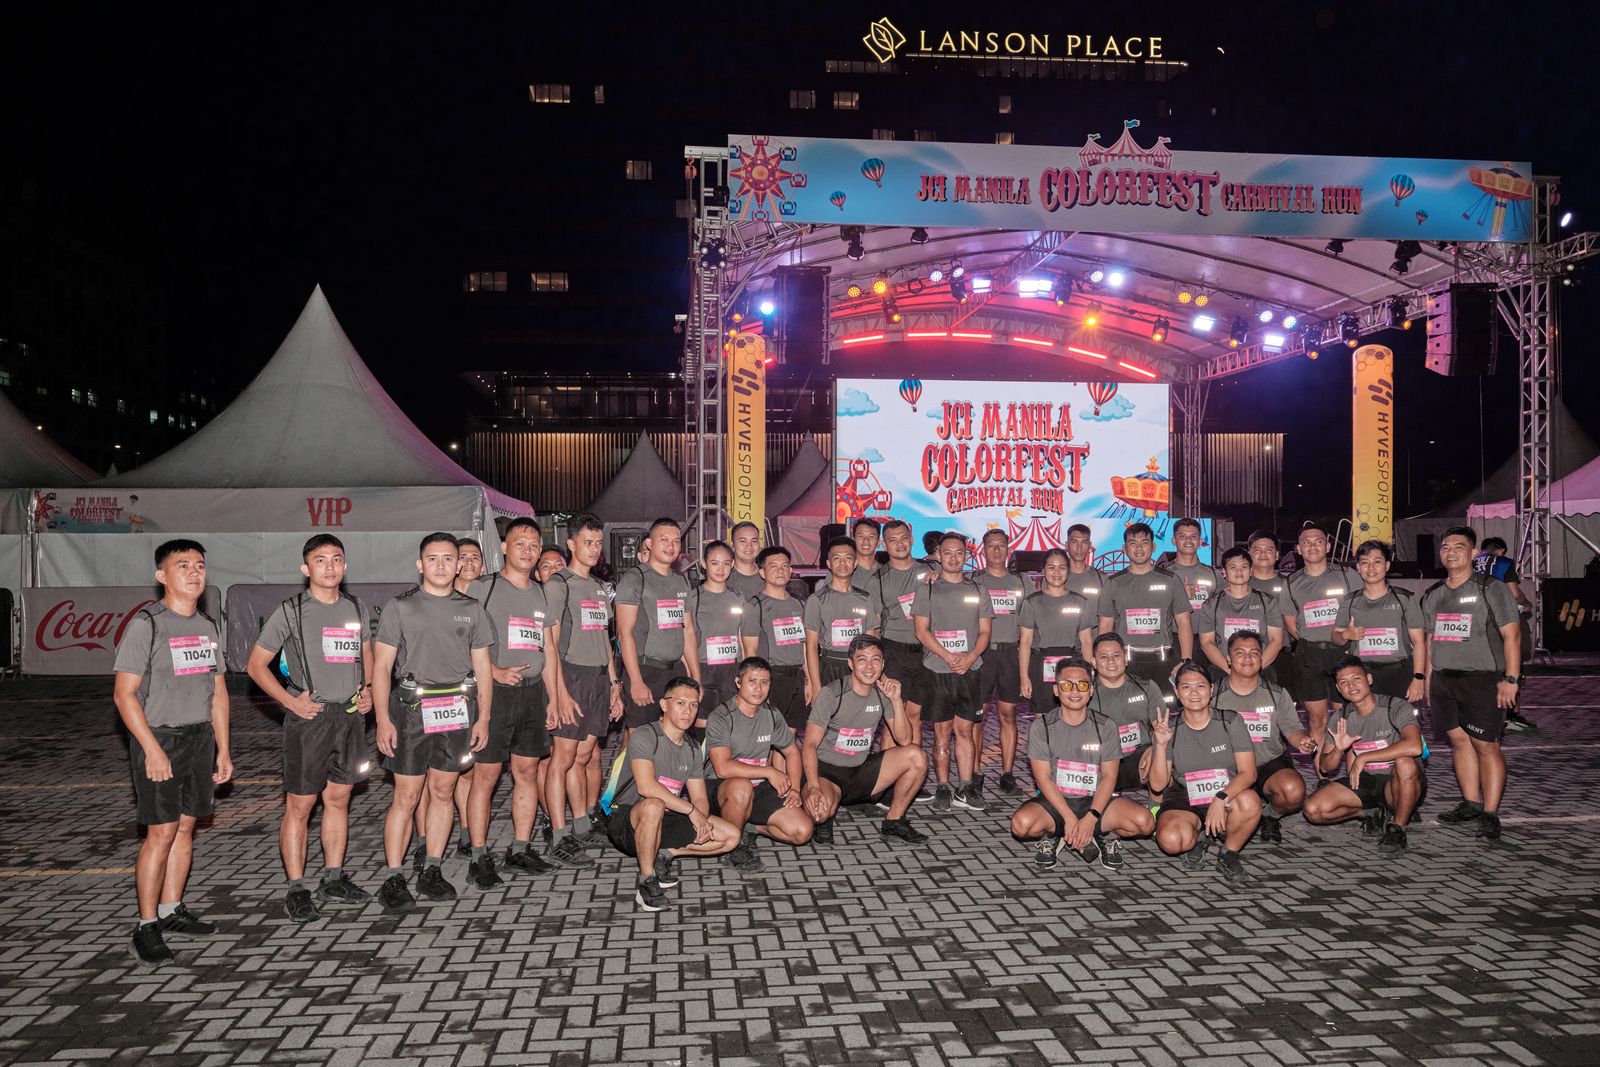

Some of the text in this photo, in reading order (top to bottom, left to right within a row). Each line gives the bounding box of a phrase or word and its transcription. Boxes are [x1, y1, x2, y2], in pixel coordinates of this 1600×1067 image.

[920, 30, 1162, 58] LANSON PLACE
[915, 168, 1363, 216] JCI MANILA COLORFEST CARNIVAL RUN
[936, 400, 1074, 441] JCI MANILA
[738, 402, 751, 521] HYVESPORTS
[920, 441, 1091, 493] COLORFEST
[1377, 411, 1389, 523] HYVESPORTS
[89, 497, 118, 507] MANILA
[946, 486, 1065, 515] CARNIVAL RUN
[70, 507, 124, 520] COLORFEST
[306, 497, 352, 527] VIP
[992, 598, 1015, 606] 11063
[588, 611, 606, 620] 11039
[667, 610, 684, 619] 11013
[1313, 607, 1337, 618] 11029
[452, 615, 471, 623] ARMY
[35, 600, 157, 651] Coca-C
[1443, 624, 1468, 632] 11042
[520, 629, 541, 641] 12183
[782, 627, 803, 636] 11034
[840, 628, 860, 637] 11023
[334, 641, 359, 651] 11035
[942, 639, 966, 648] 11067
[1368, 638, 1395, 646] 11043
[183, 649, 211, 661] 11047
[718, 647, 737, 655] 11015
[1127, 695, 1145, 703] ARMY
[433, 708, 465, 720] 11054
[1256, 706, 1274, 714] ARMY
[1248, 723, 1268, 732] 066
[1466, 724, 1485, 735] ARMY
[846, 738, 869, 747] 11028
[1119, 733, 1138, 744] 1022
[1066, 773, 1094, 785] 11065
[1196, 781, 1227, 793] 11064
